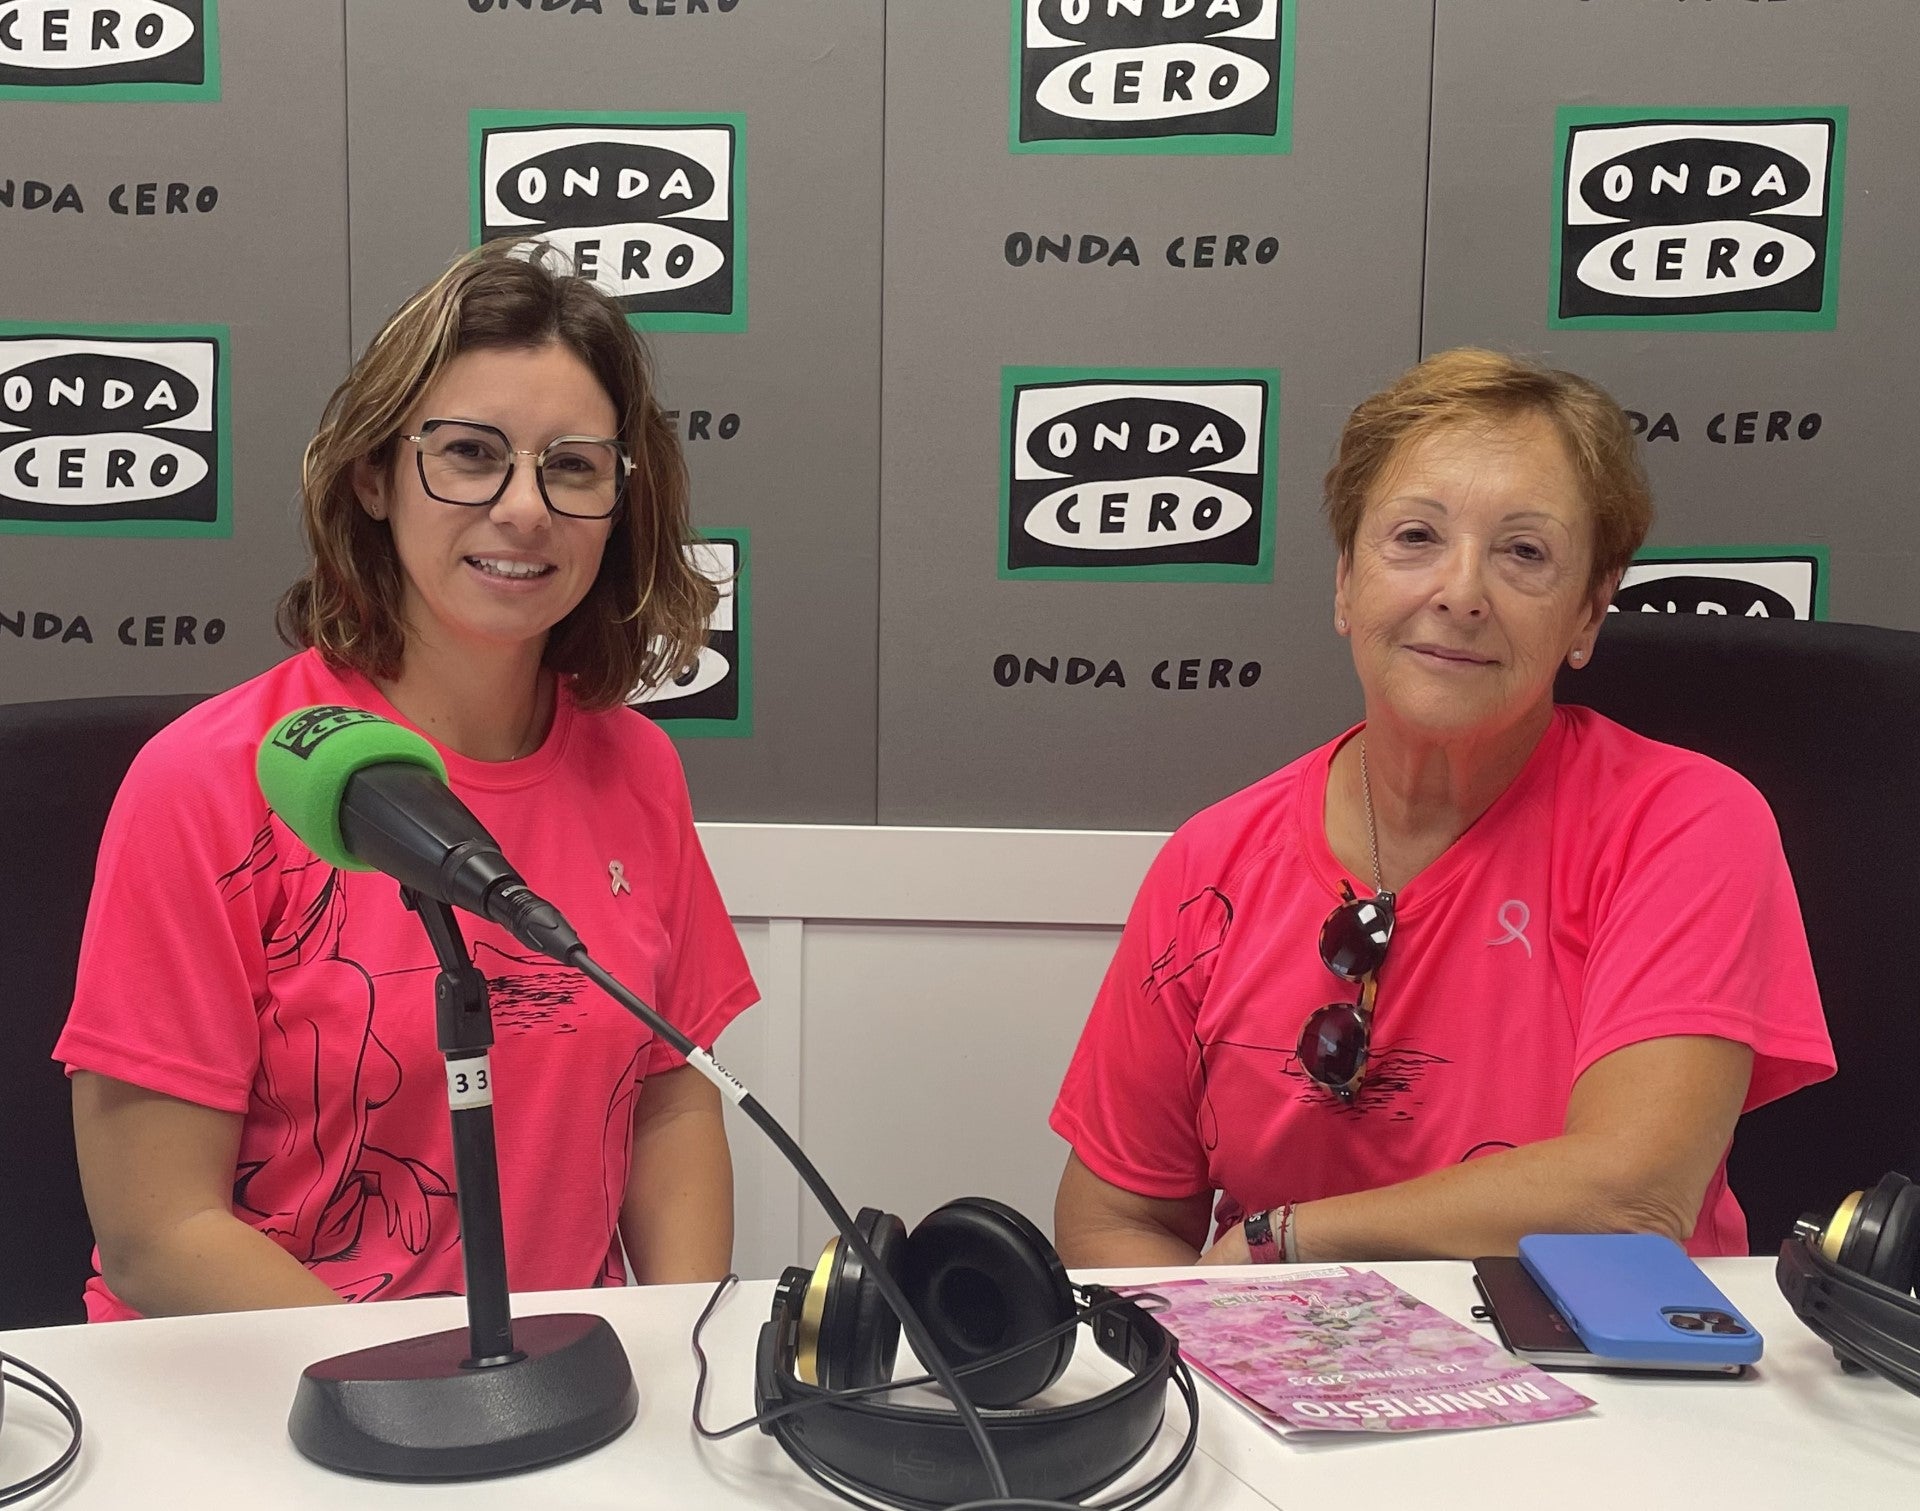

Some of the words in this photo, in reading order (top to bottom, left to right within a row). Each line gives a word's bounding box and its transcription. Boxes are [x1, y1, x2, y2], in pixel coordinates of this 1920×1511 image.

[0, 9, 164, 51] CERO
[1068, 60, 1239, 104] CERO
[108, 183, 219, 215] CERO
[517, 166, 693, 204] ONDA
[1603, 163, 1787, 202] ONDA
[1004, 231, 1140, 267] ONDA
[1166, 234, 1280, 268] CERO
[1610, 237, 1785, 281] CERO
[3, 376, 178, 412] ONDA
[1048, 421, 1224, 459] ONDA
[1706, 410, 1822, 444] CERO
[14, 447, 179, 488] CERO
[1056, 492, 1223, 534] CERO
[118, 615, 226, 647] CERO
[993, 654, 1126, 688] ONDA
[1151, 658, 1262, 690] CERO
[1287, 1374, 1351, 1386] 2023
[1292, 1381, 1551, 1418] MANIFIESTO
